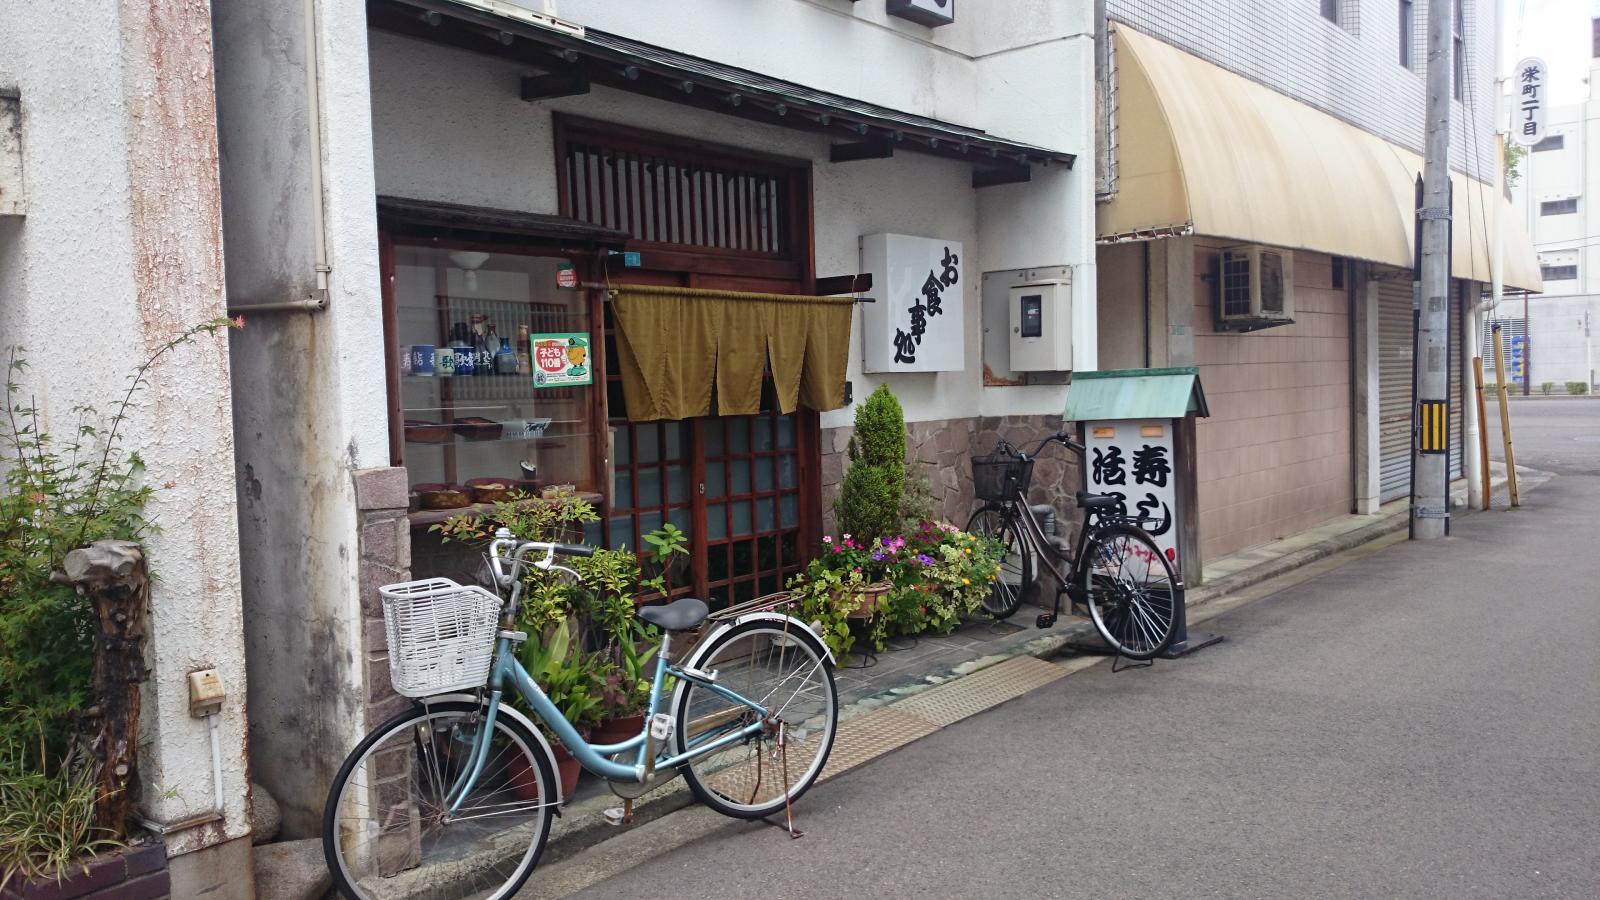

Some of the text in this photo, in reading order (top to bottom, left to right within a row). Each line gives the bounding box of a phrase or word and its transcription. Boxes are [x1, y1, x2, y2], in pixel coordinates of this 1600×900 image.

[1521, 66, 1542, 136] 栄町一丁目
[893, 246, 959, 364] お食事処
[540, 347, 561, 358] 子ども
[1132, 444, 1172, 537] 寿し
